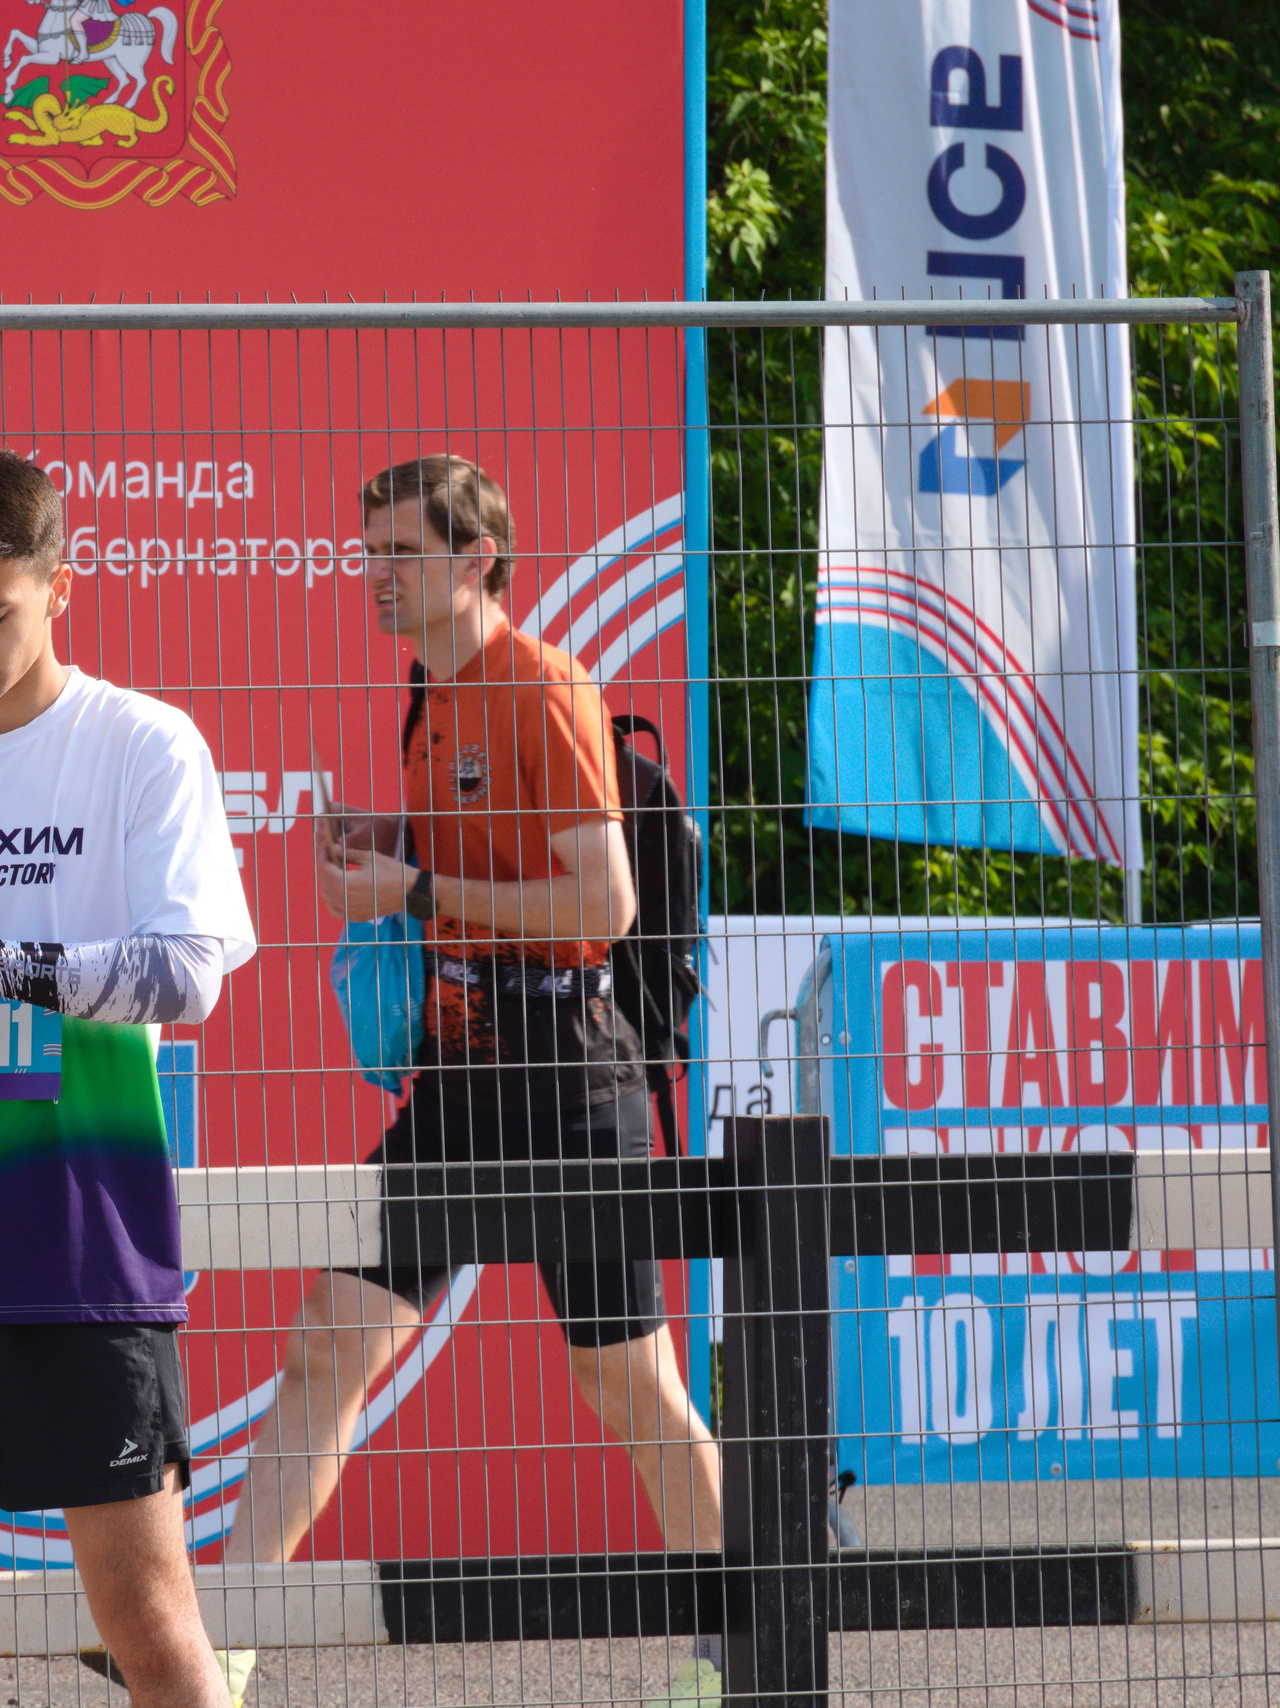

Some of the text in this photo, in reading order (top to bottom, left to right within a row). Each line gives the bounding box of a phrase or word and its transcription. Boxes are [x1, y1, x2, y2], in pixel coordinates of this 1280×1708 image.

[26, 449, 254, 508] оманда
[60, 526, 368, 588] бернатора
[882, 959, 1268, 1111] СТАВИМ
[888, 1290, 1197, 1445] 10 ЛЕТ
[109, 1453, 149, 1467] DEMIX
